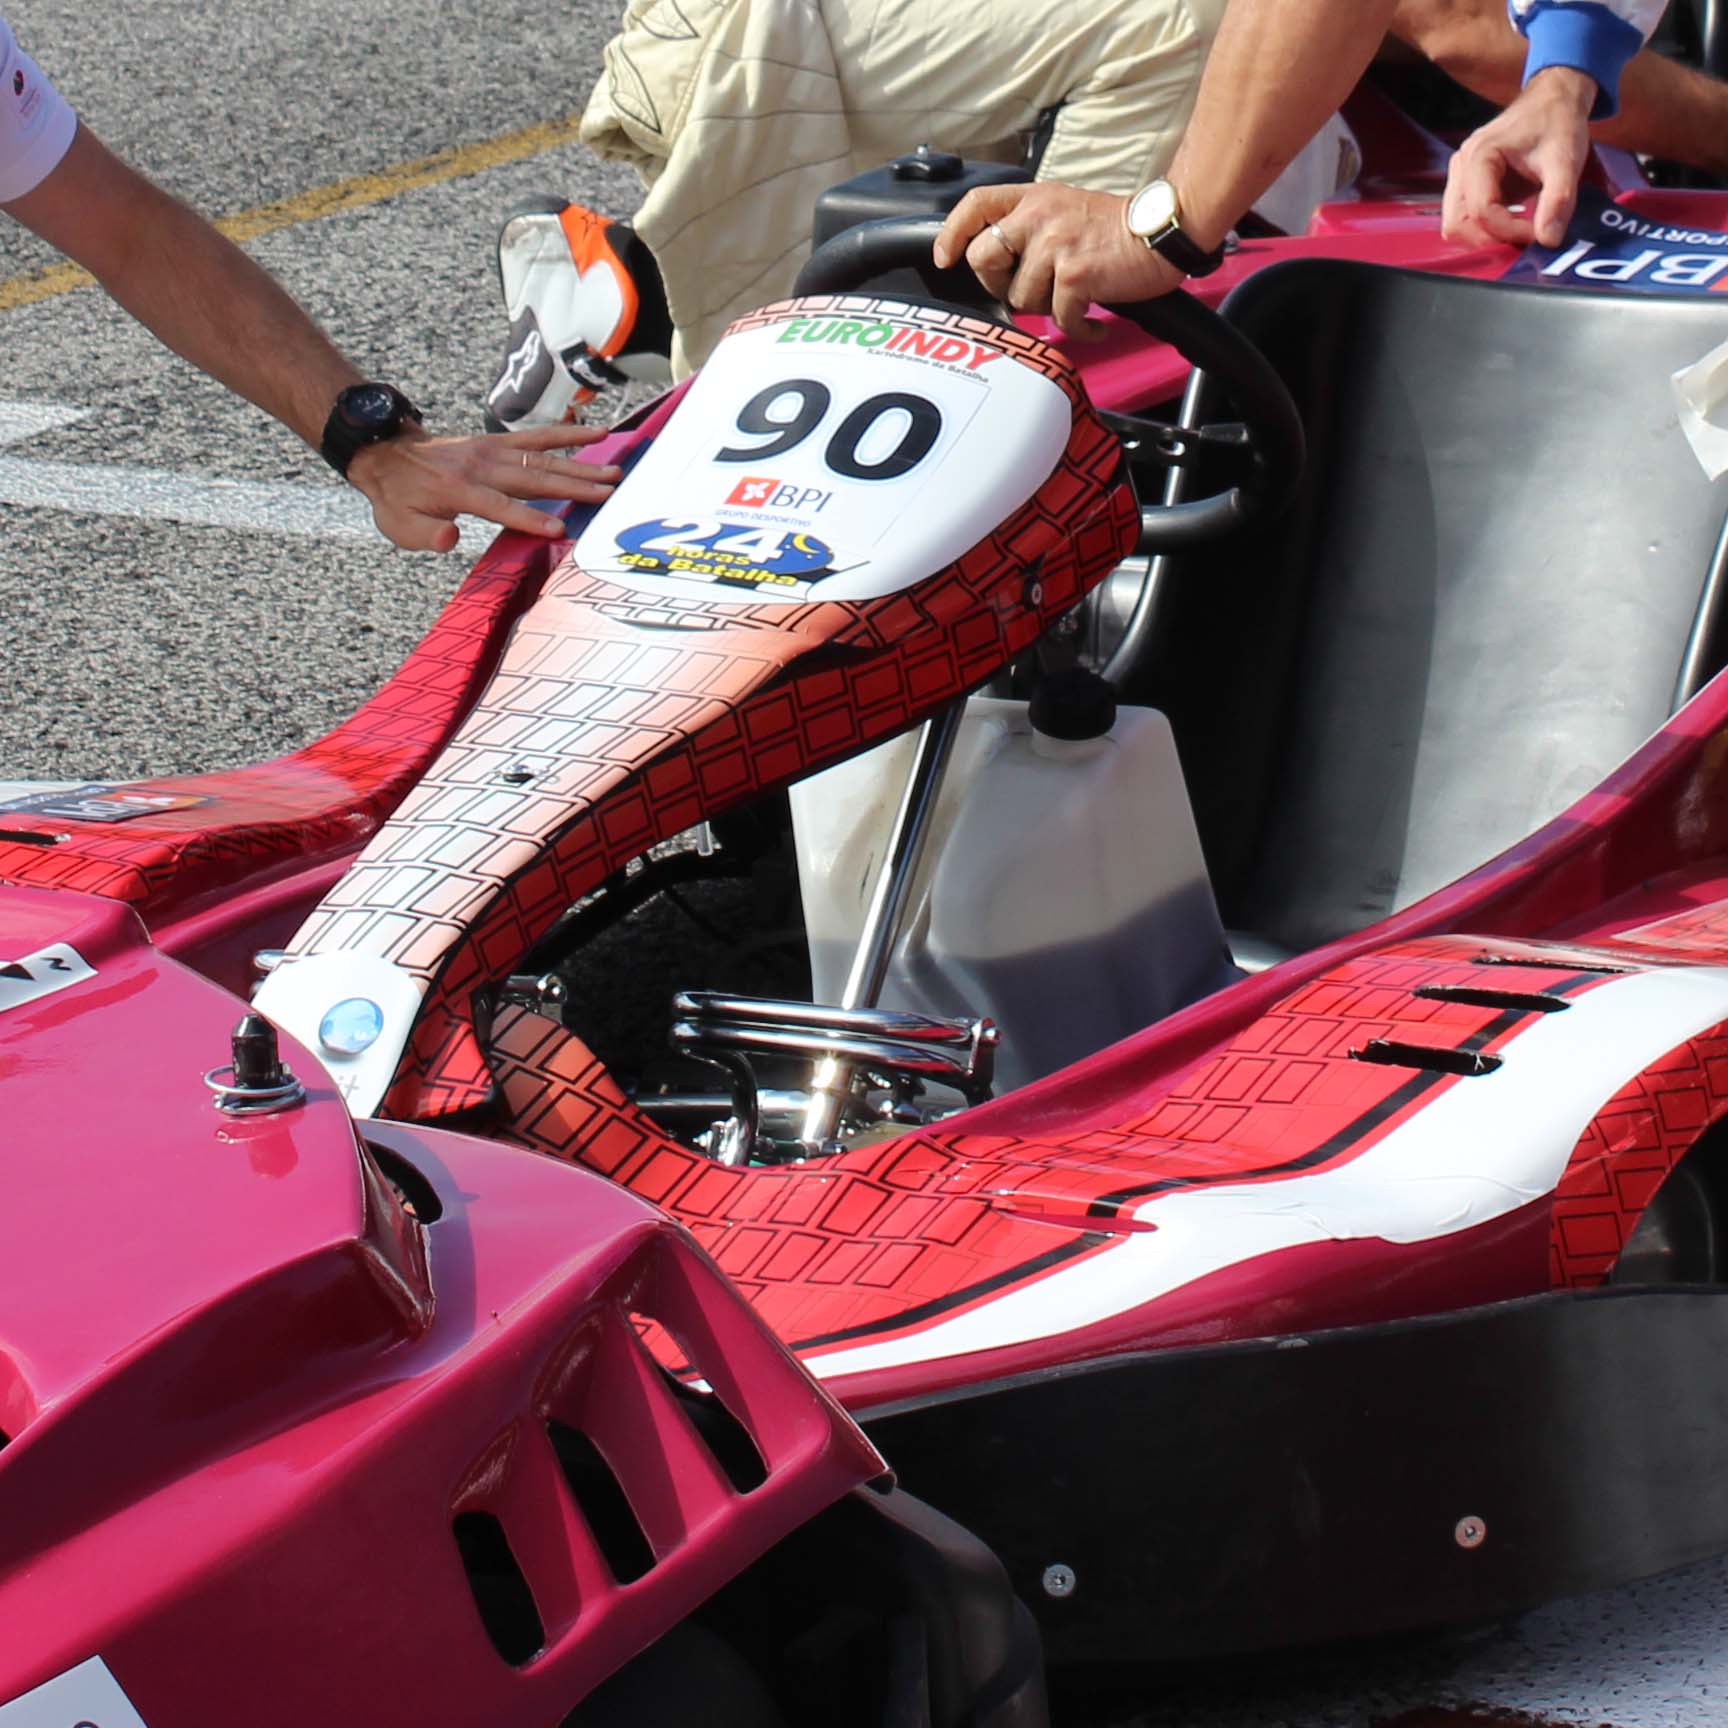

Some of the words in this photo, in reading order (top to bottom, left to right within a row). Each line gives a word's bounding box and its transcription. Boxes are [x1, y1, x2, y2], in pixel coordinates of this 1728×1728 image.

[776, 318, 1005, 371] EUROINDY
[712, 377, 943, 481] 90
[770, 483, 834, 513] BPI
[639, 518, 791, 565] 24
[666, 545, 753, 566] horas
[618, 553, 661, 568] da
[668, 558, 799, 587] Batalha
